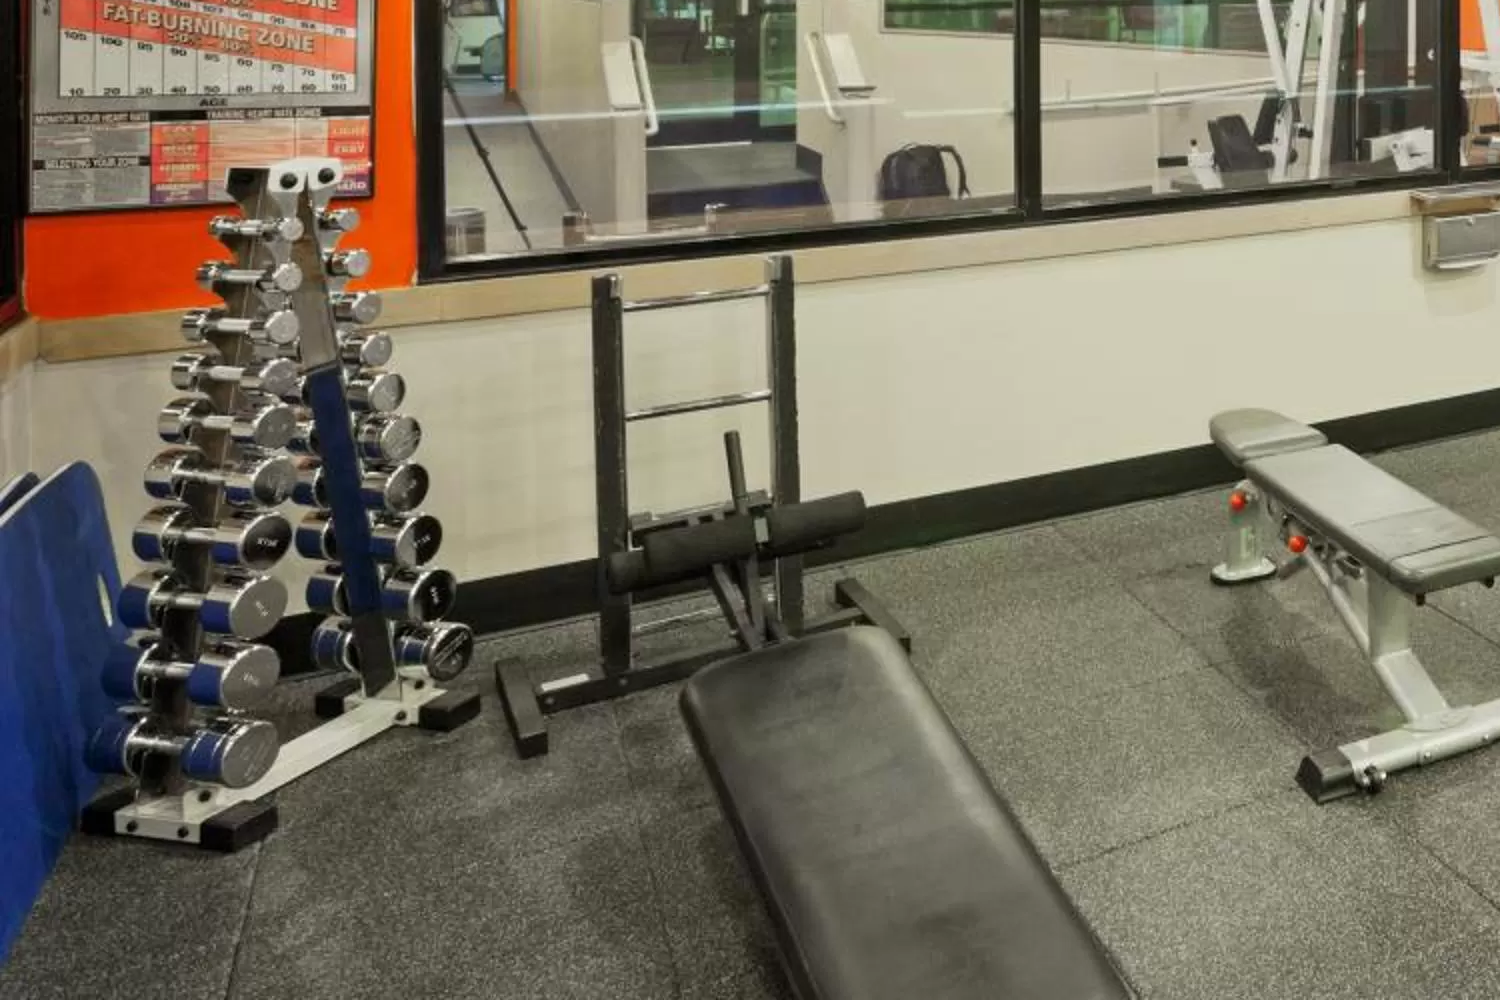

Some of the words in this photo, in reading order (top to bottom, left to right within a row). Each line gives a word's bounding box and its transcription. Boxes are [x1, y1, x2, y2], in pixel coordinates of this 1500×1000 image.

[103, 2, 250, 42] FAT-BURNING
[256, 27, 315, 54] ZONE
[69, 87, 85, 96] 10
[103, 87, 121, 96] 20
[170, 86, 187, 95] 40
[203, 85, 220, 93] 50
[271, 84, 285, 92] 70
[199, 97, 228, 107] AGE
